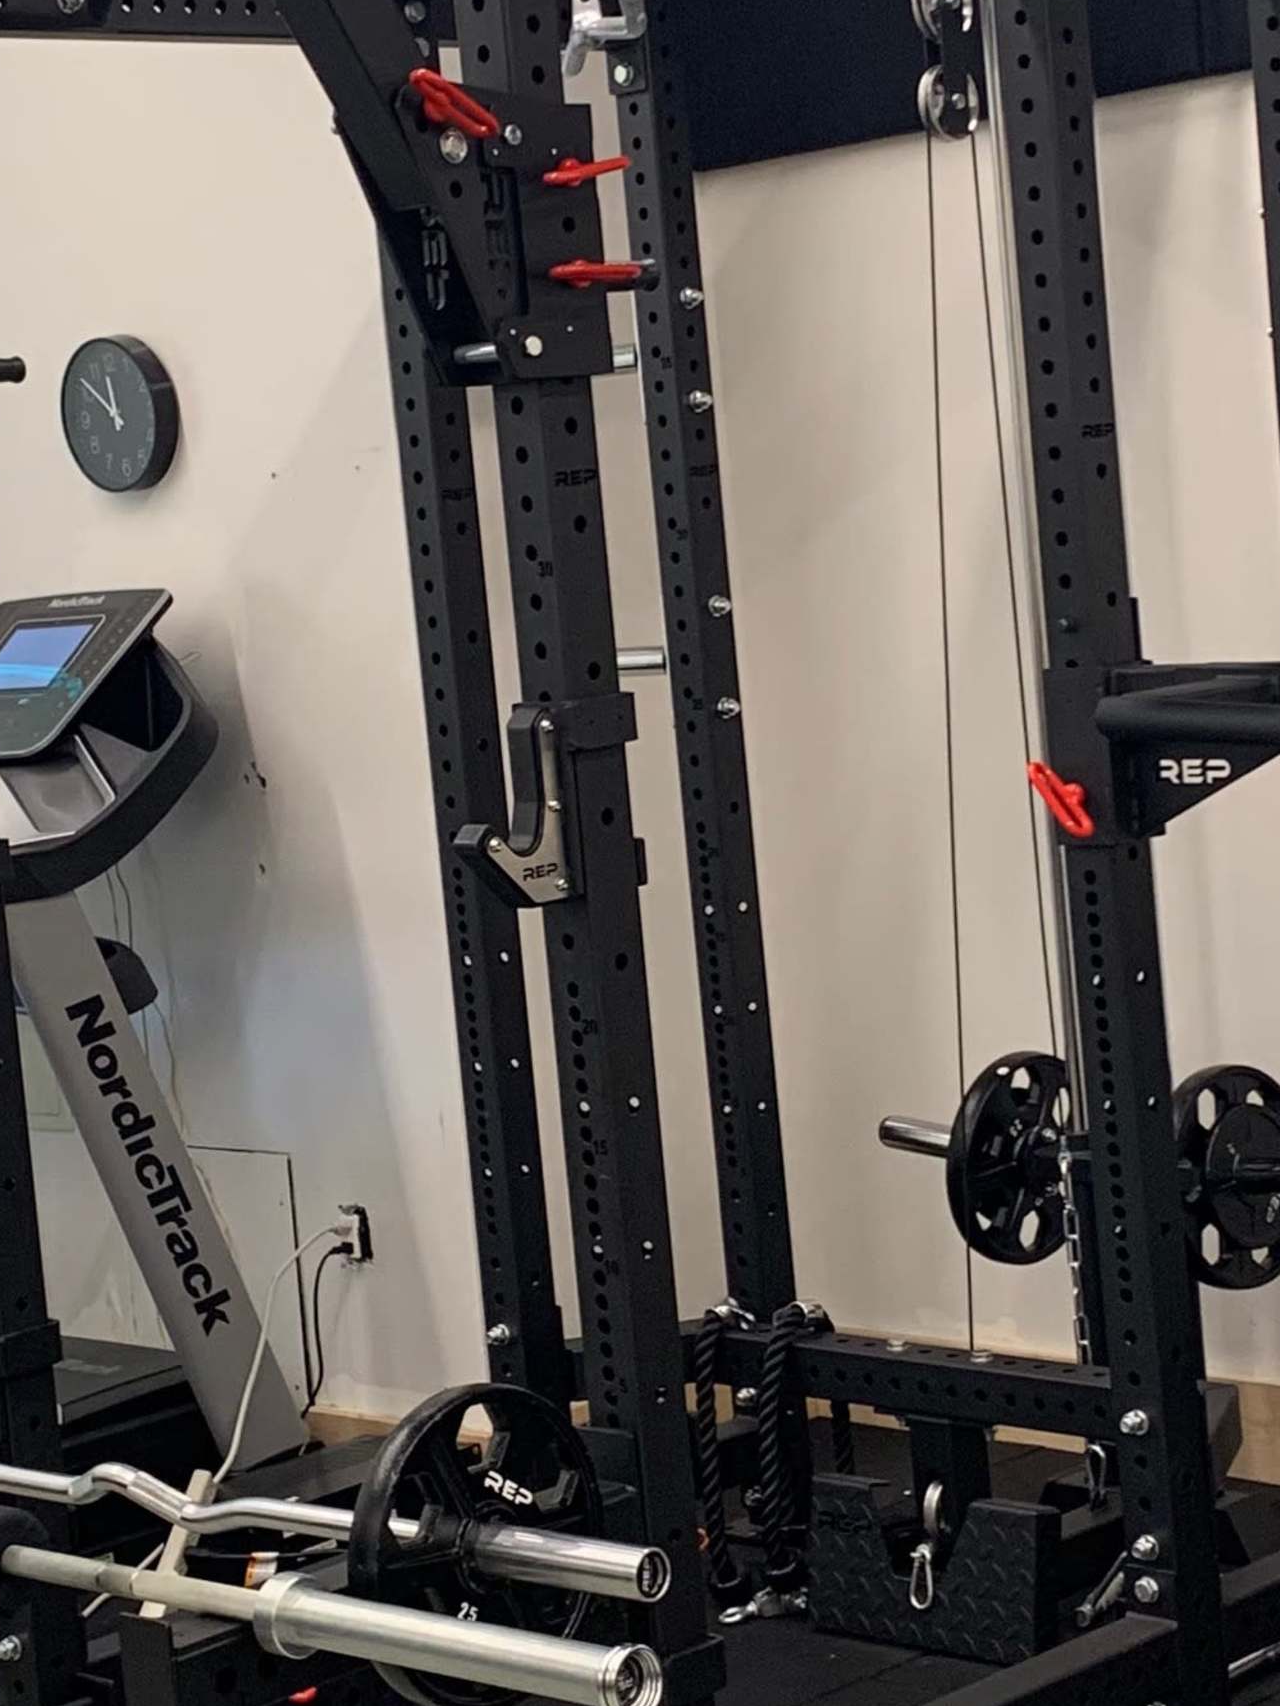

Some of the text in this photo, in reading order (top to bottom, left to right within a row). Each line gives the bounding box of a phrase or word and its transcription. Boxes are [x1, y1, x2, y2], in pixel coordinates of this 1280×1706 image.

[553, 468, 597, 487] REP
[1159, 759, 1231, 784] REP
[522, 862, 558, 882] REP
[64, 994, 231, 1336] NordicTrack
[484, 1470, 533, 1506] REP
[457, 1602, 479, 1622] 25
